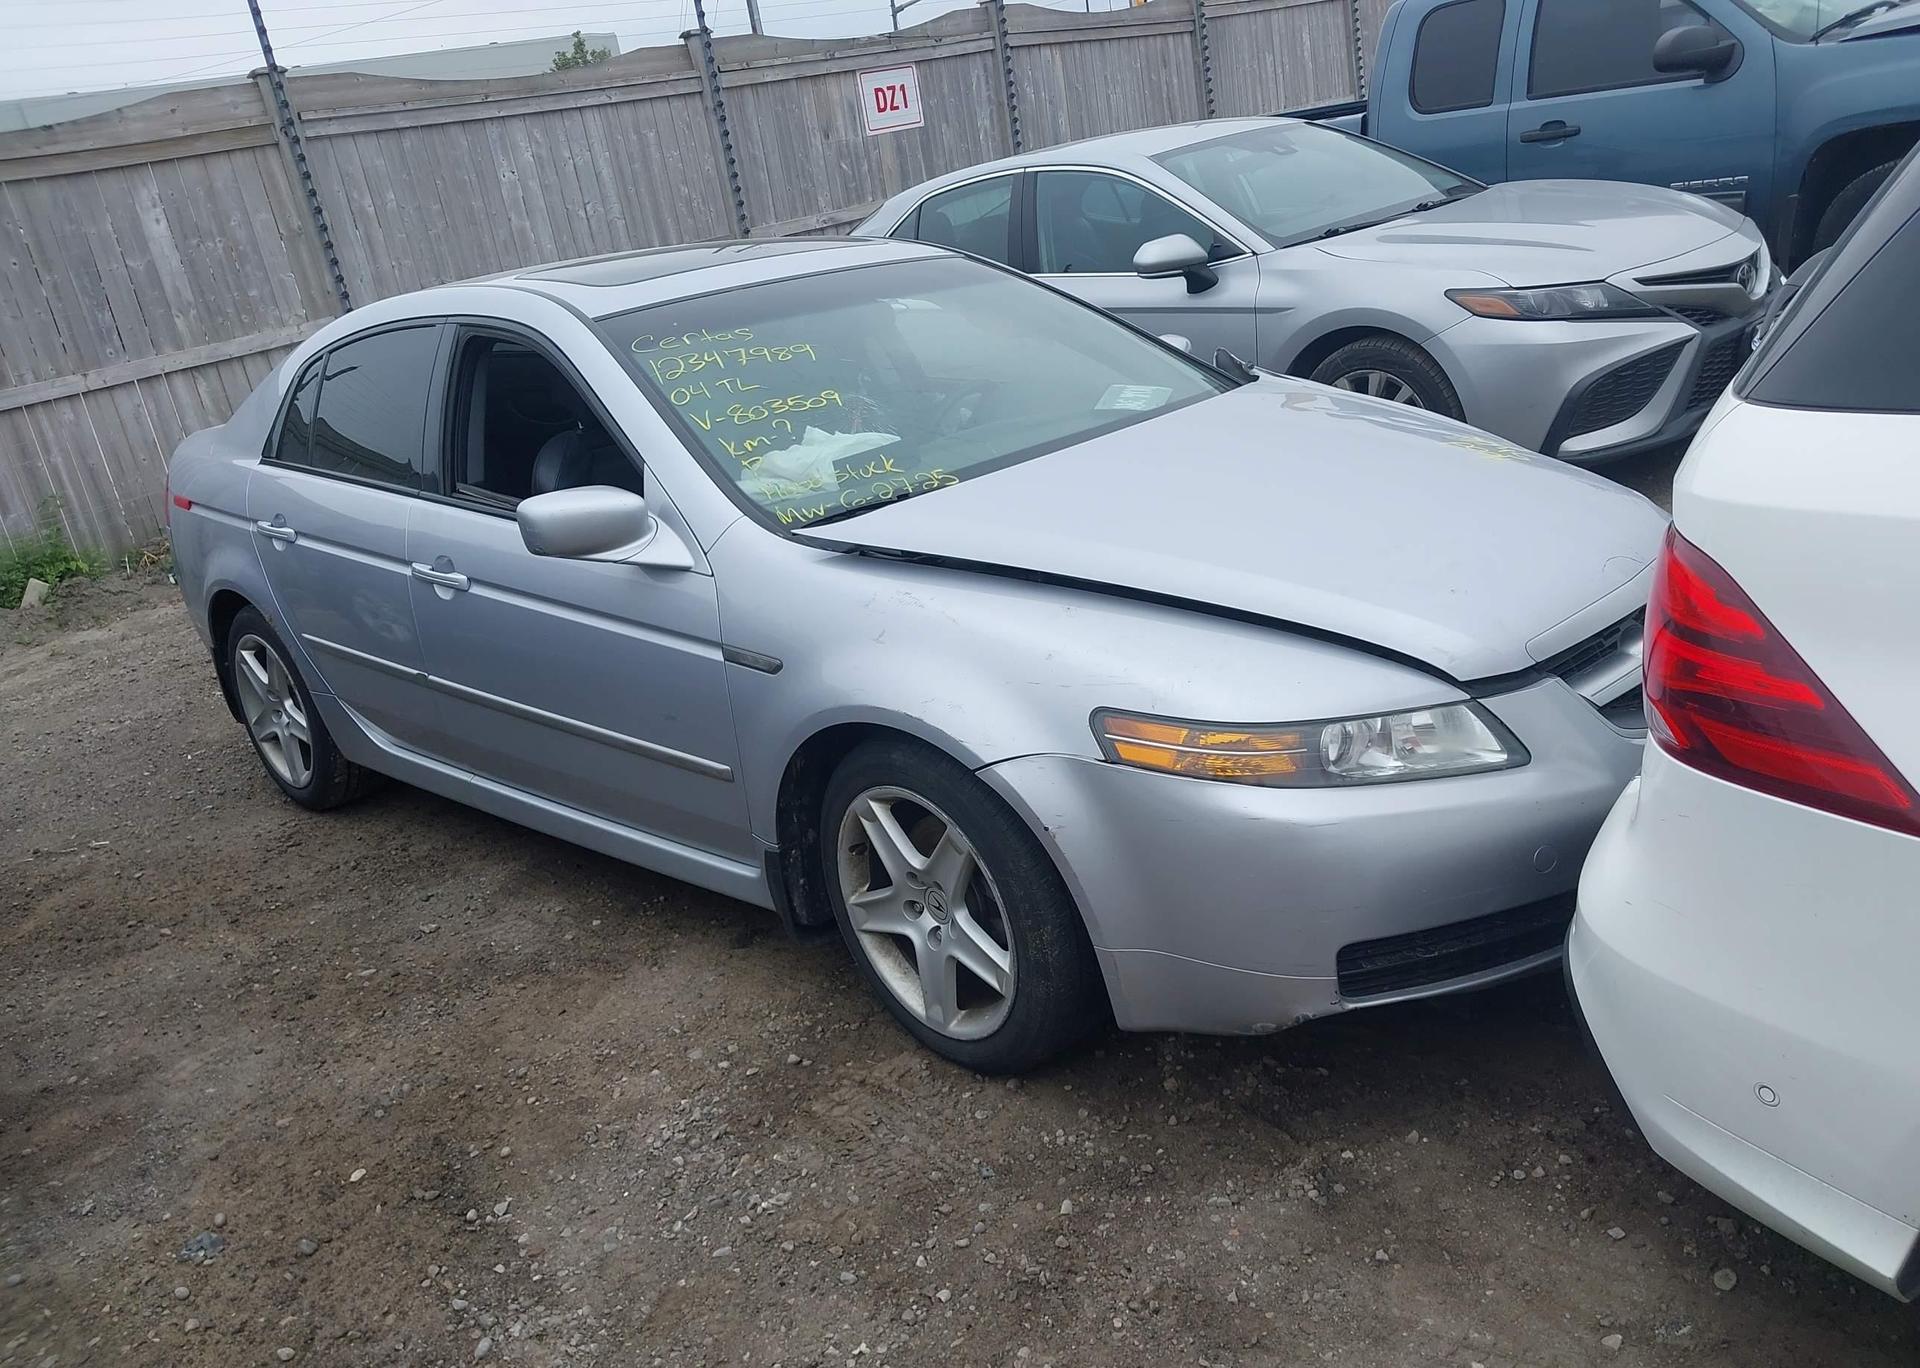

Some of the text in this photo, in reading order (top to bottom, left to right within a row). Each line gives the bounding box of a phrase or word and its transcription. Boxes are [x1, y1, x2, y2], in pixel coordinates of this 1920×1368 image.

[873, 83, 909, 113] DZ1
[631, 328, 754, 353] Certas
[649, 343, 817, 384] 12347989
[670, 377, 763, 406] 04 TL
